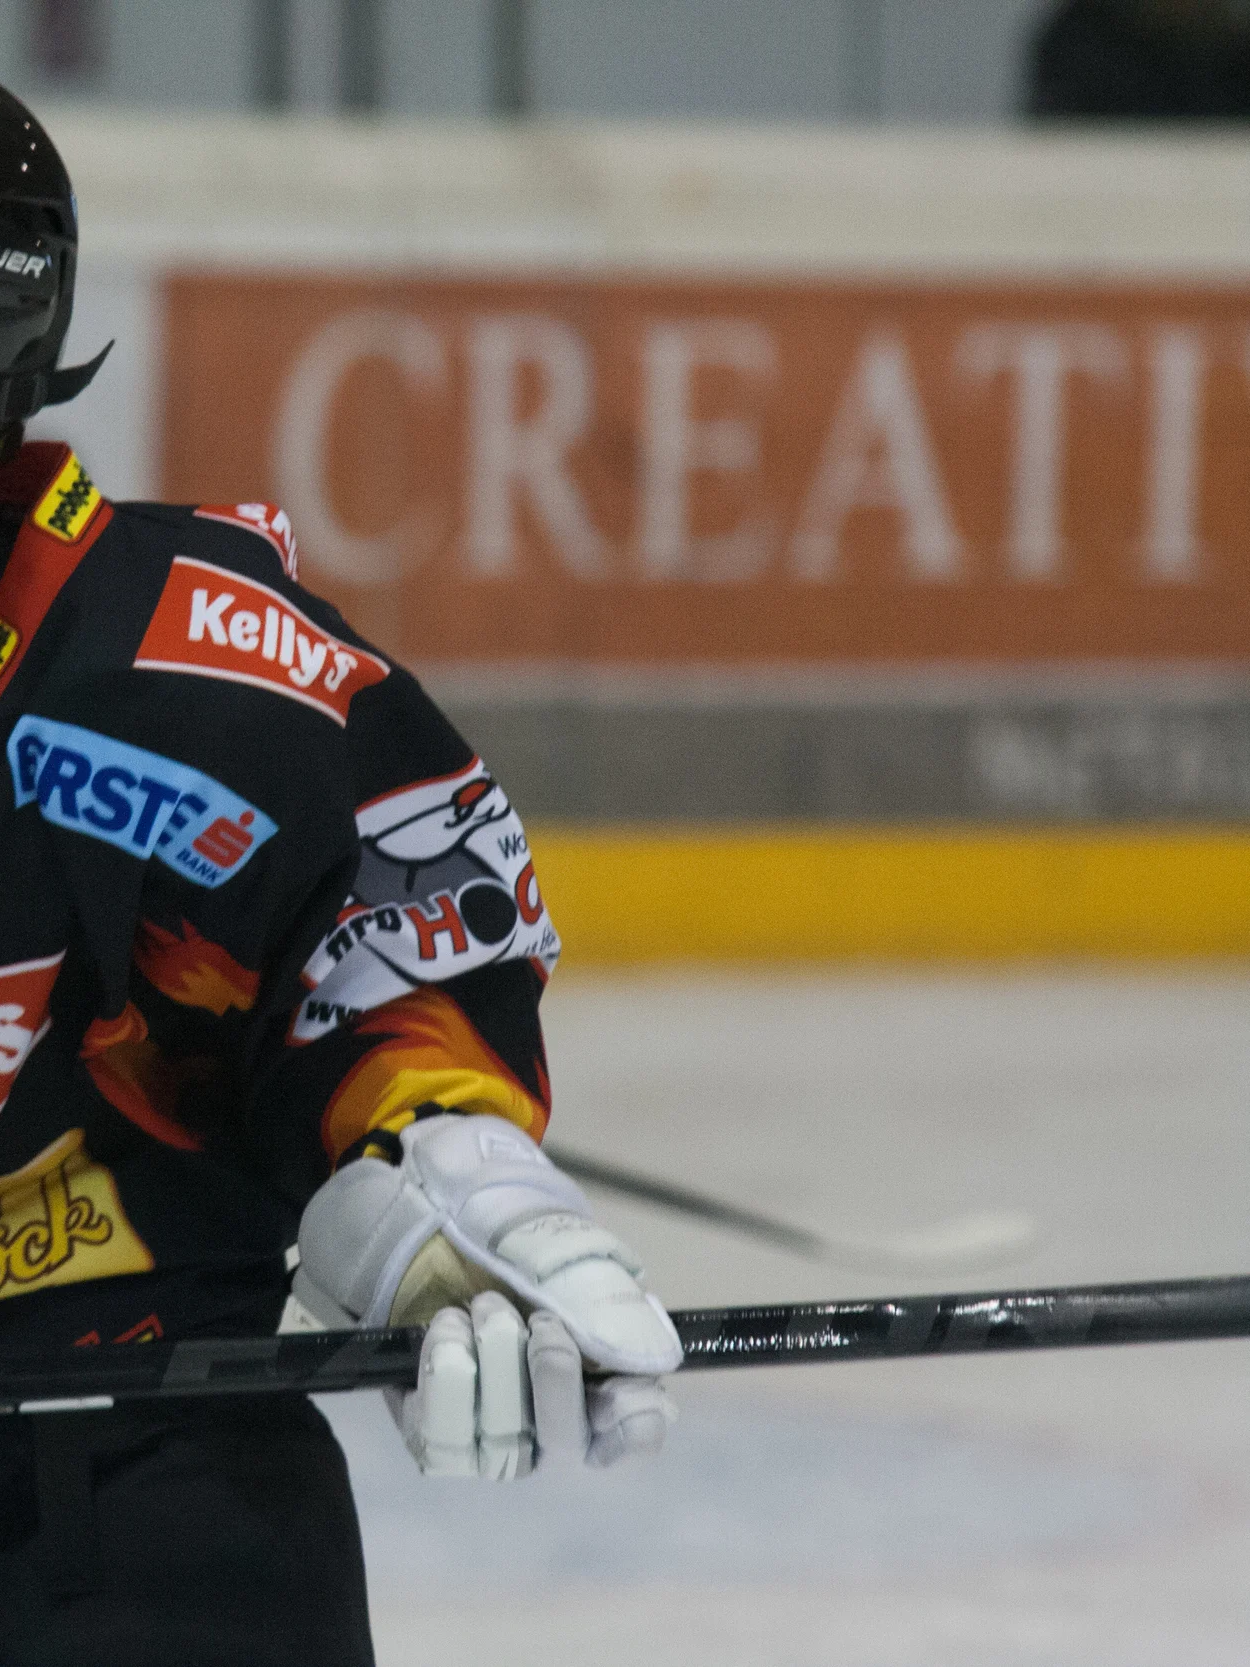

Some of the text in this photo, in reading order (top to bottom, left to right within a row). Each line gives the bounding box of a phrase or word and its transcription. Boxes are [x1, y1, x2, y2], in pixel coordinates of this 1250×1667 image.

[270, 308, 1250, 585] CREATI
[188, 588, 359, 692] Kelly's
[174, 847, 223, 884] BANK
